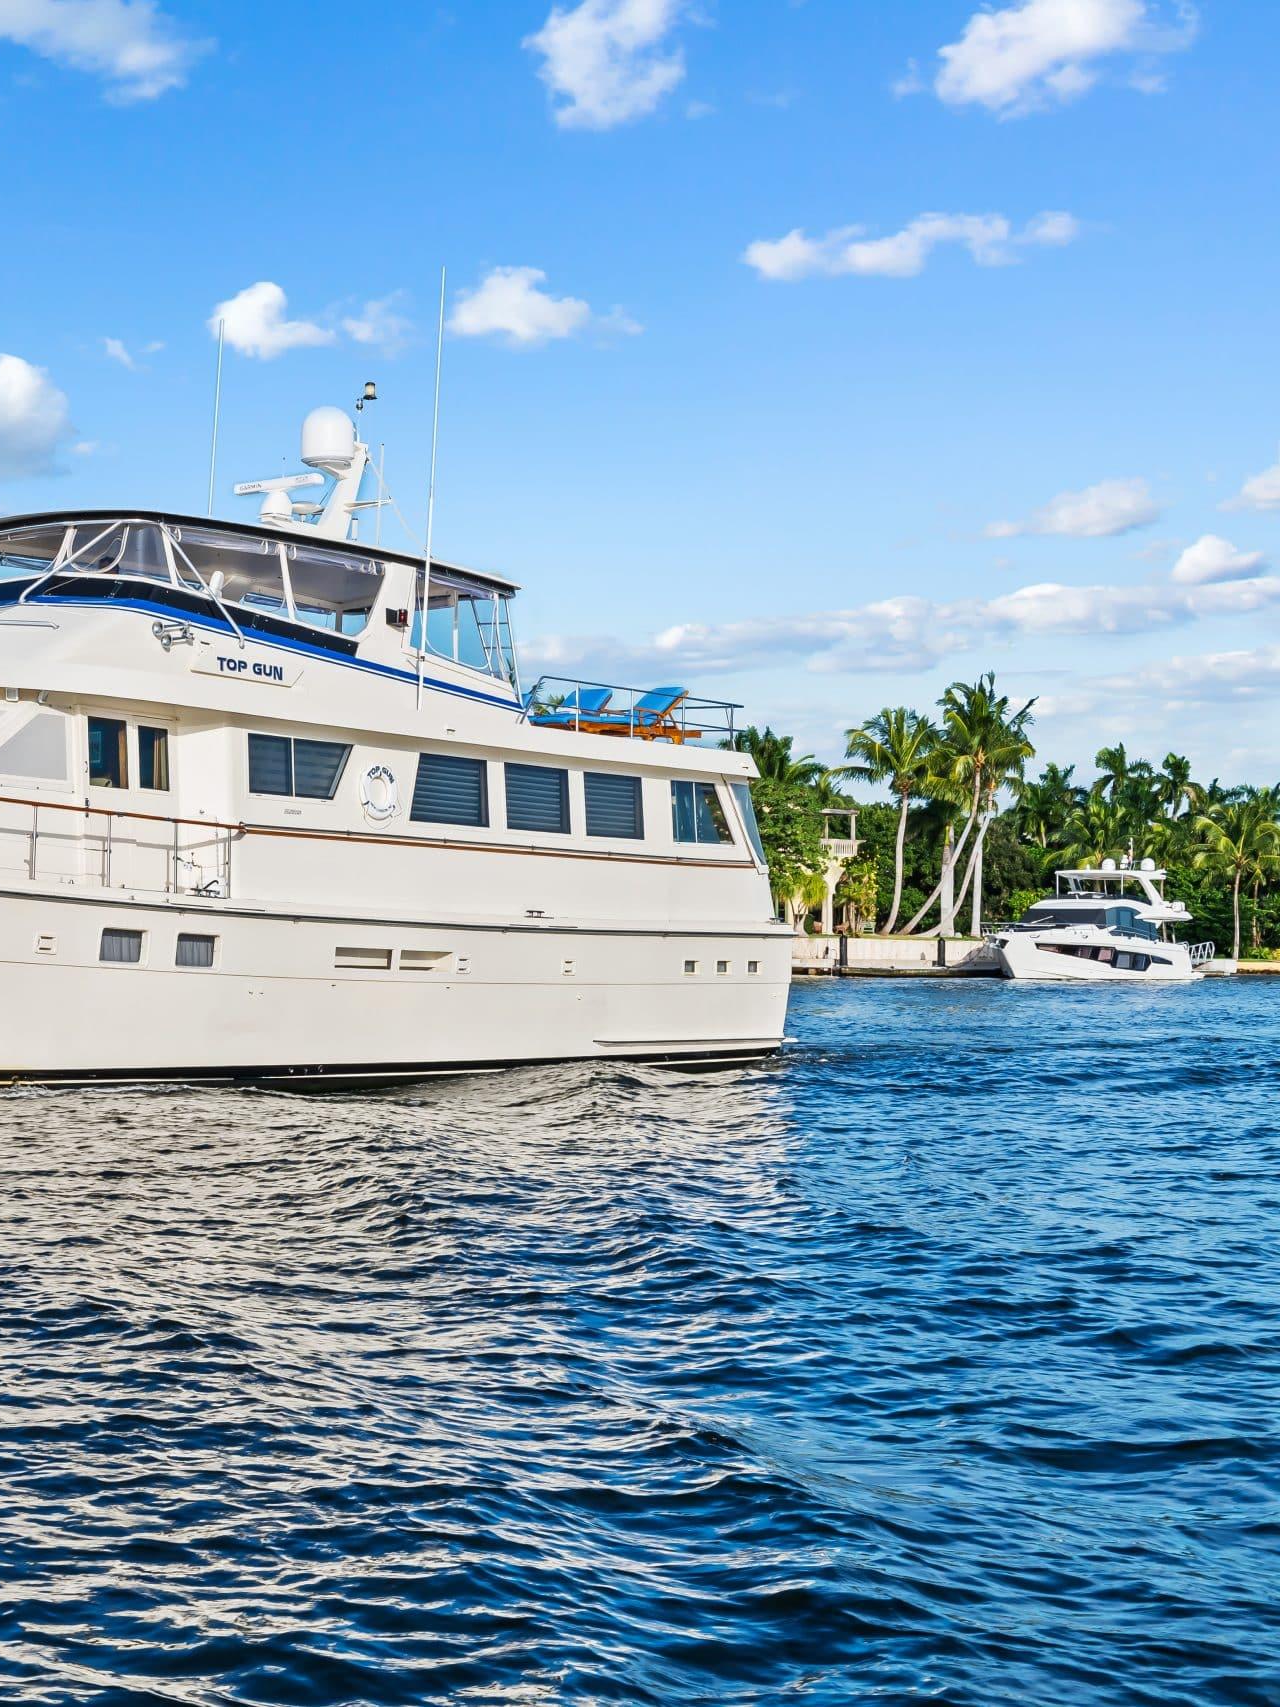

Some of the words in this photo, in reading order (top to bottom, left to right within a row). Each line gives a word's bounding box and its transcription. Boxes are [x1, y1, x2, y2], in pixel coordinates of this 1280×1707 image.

[217, 656, 248, 672] TOP
[252, 663, 283, 681] GUN
[367, 765, 380, 779] TOP
[382, 766, 395, 784] GUN
